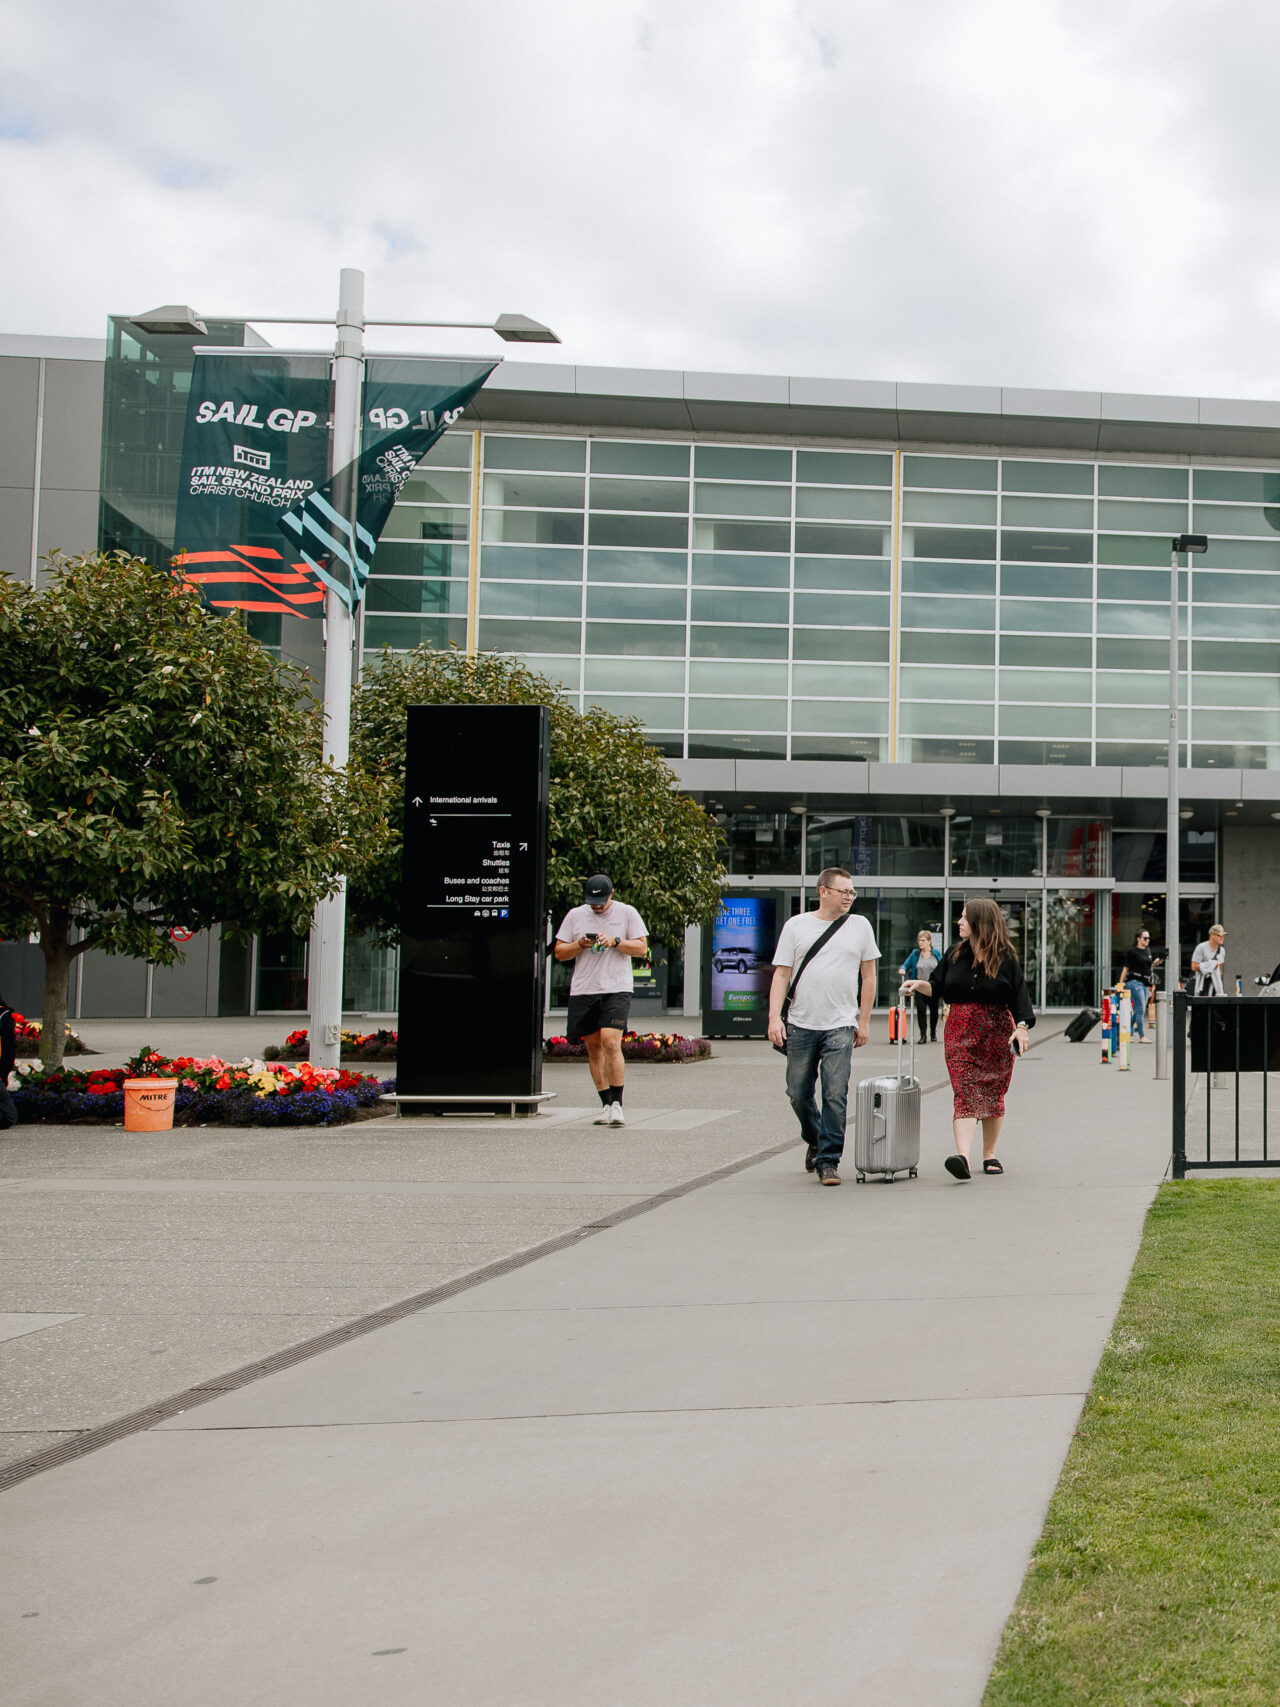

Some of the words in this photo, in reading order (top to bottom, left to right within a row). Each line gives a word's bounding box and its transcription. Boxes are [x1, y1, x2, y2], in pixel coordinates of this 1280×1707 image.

[191, 466, 215, 477] ITM
[216, 466, 249, 479] NEW
[250, 472, 314, 490] ZEALAND
[190, 475, 219, 485] SAIL
[221, 477, 271, 495] GRAND
[272, 487, 305, 500] PRIX
[189, 484, 292, 508] CHRISTCHURCH
[430, 796, 471, 804] International
[472, 796, 498, 804] arrivals
[491, 841, 511, 849] Taxis
[482, 859, 511, 867] Shuttles
[444, 877, 466, 885] Buses
[466, 877, 480, 885] and
[481, 877, 510, 885] coaches
[445, 895, 463, 903] Long
[464, 895, 480, 903] Stay
[493, 895, 509, 904] park
[731, 907, 751, 916] THREE
[728, 917, 741, 926] ONE
[139, 1093, 168, 1101] MITRE
